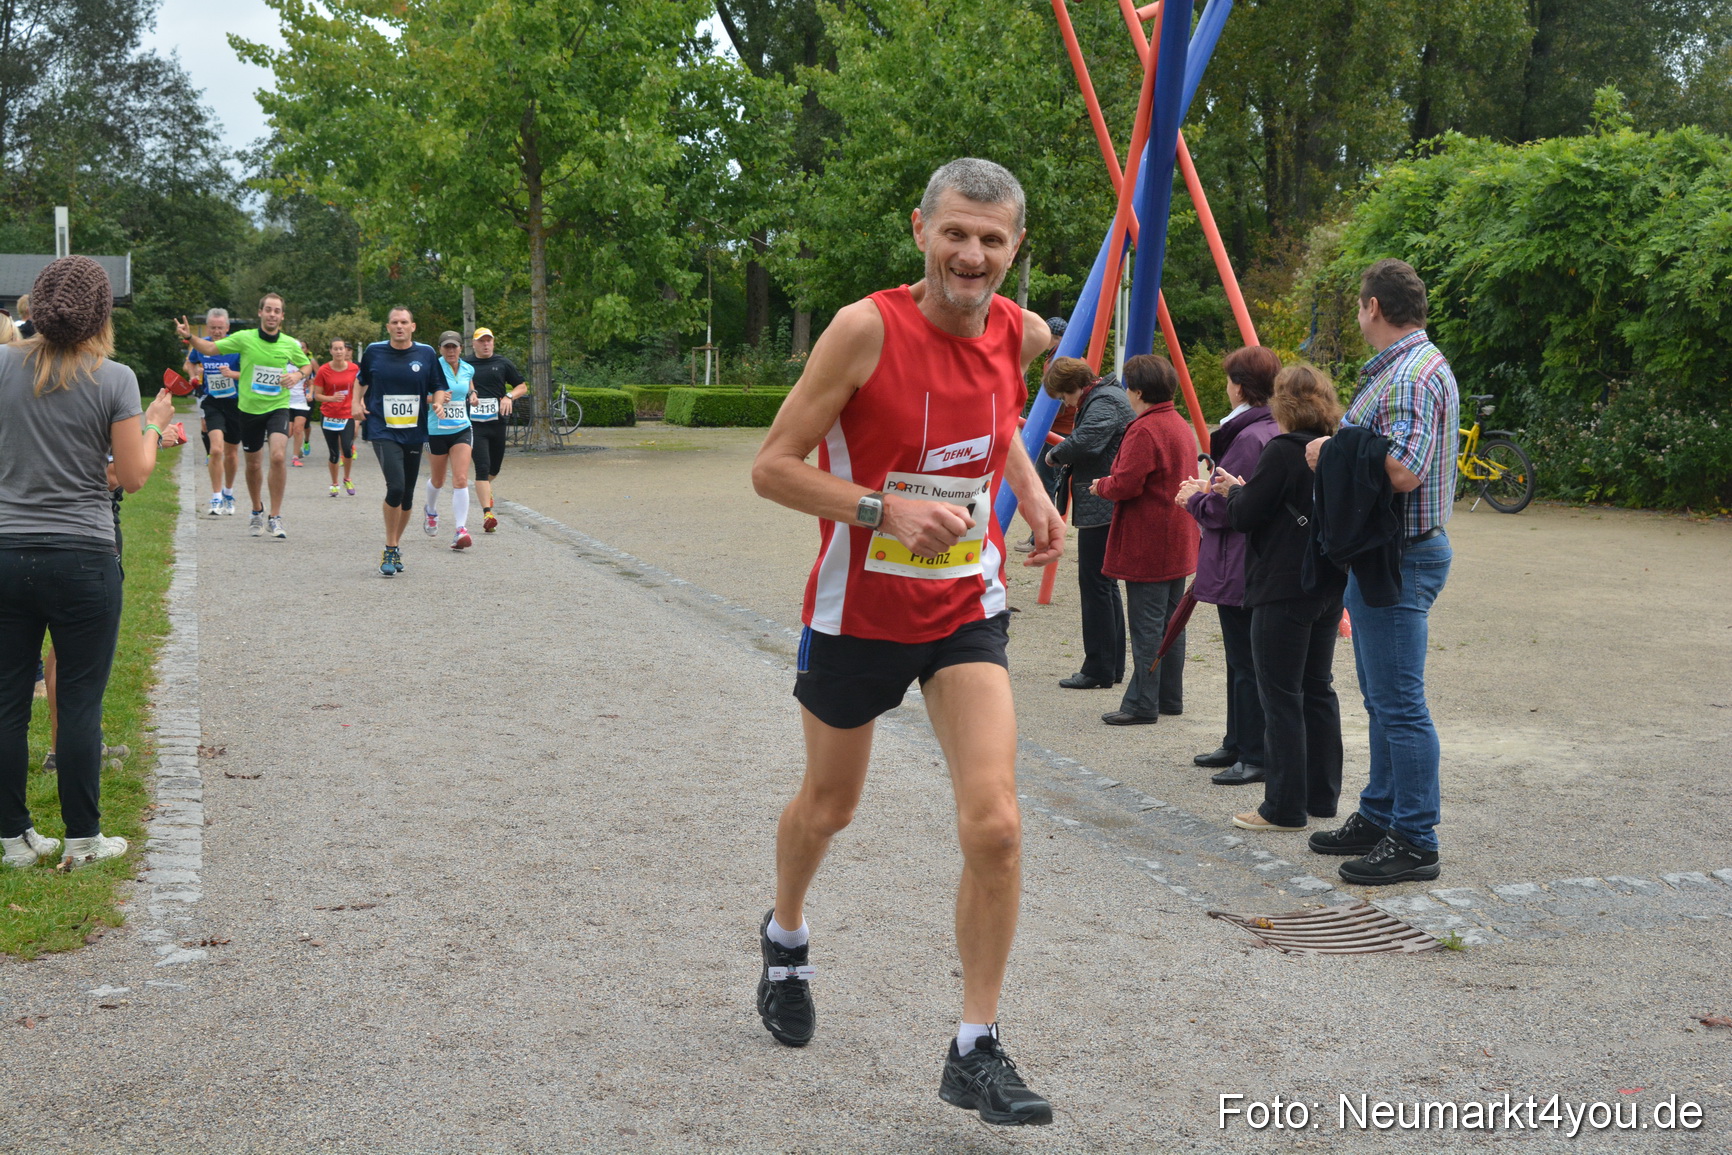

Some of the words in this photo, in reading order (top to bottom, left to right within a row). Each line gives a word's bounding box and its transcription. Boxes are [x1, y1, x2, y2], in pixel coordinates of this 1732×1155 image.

[210, 379, 231, 390] 2667
[255, 372, 280, 385] 2223
[391, 403, 413, 416] 604
[473, 403, 496, 414] 3418
[942, 446, 973, 462] DEHN
[931, 486, 980, 499] Neumarkt
